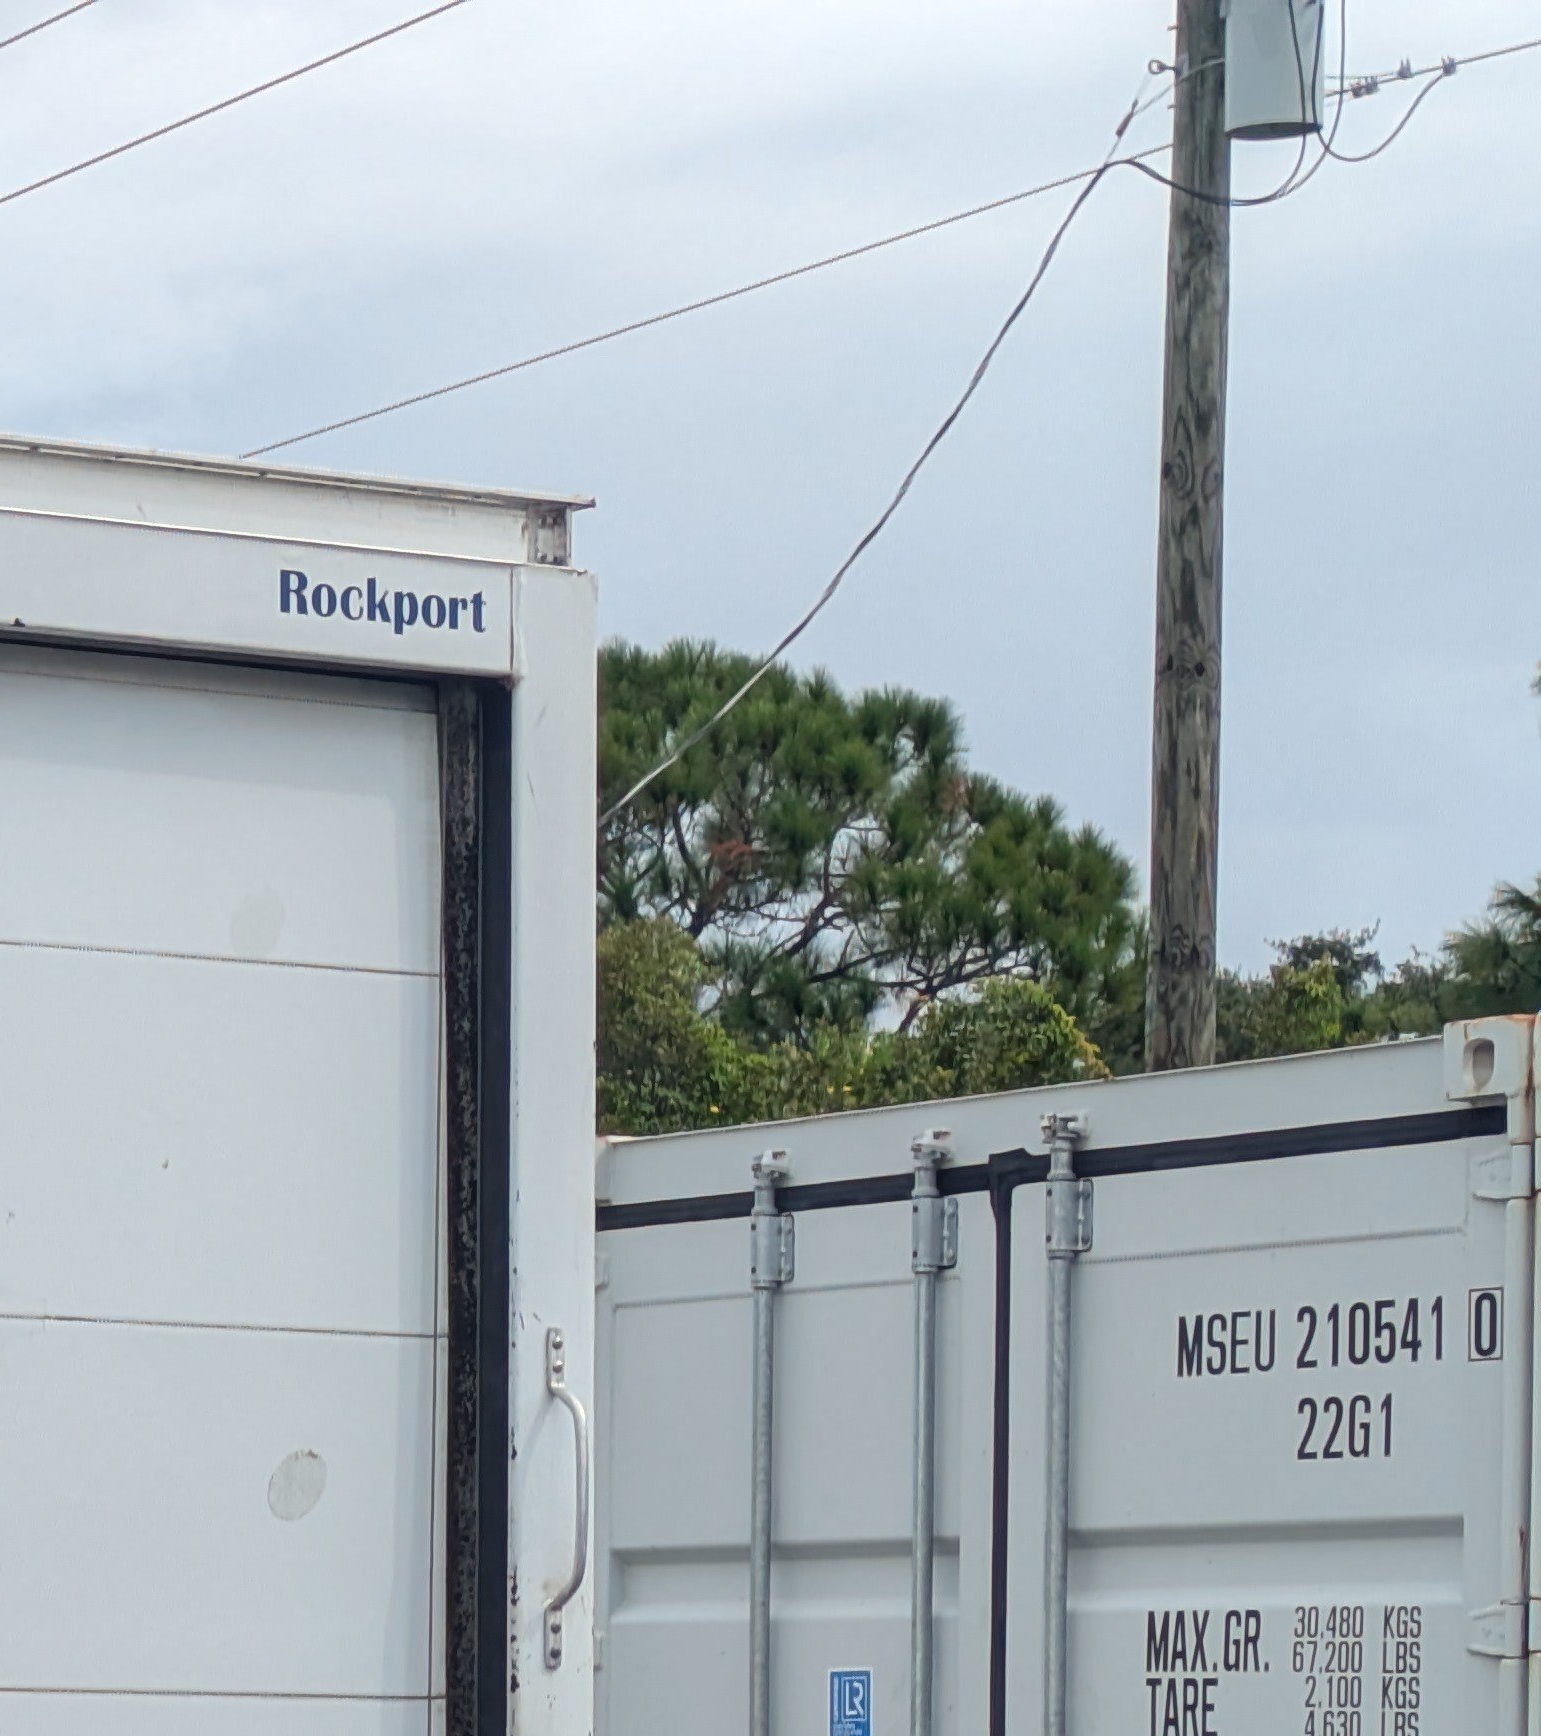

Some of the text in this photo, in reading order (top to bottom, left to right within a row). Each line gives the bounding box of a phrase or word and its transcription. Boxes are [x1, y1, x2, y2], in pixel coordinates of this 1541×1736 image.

[280, 569, 487, 635] Rockport
[1177, 1292, 1497, 1378] MSEU 210541 0
[1297, 1393, 1392, 1460] 22G1
[1383, 1606, 1422, 1639] KGS
[1382, 1641, 1421, 1674] LBS
[1381, 1676, 1420, 1710] KGS
